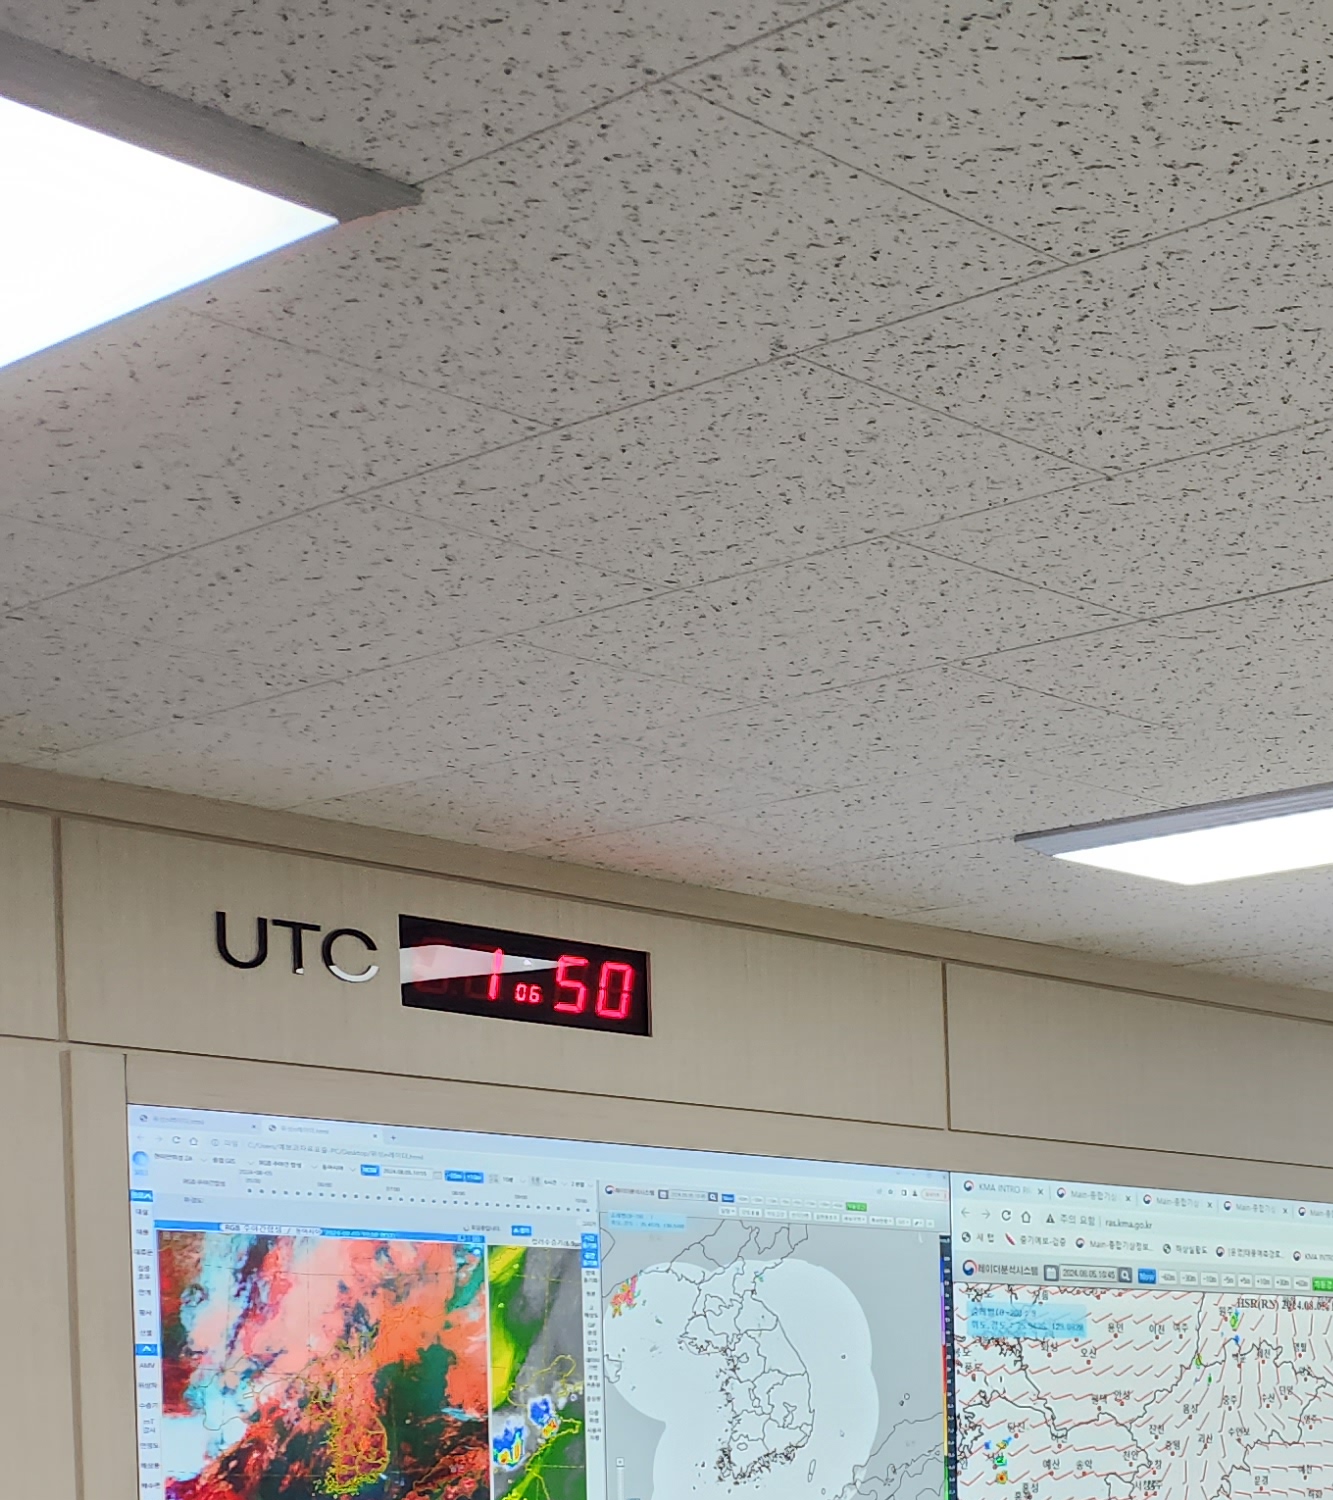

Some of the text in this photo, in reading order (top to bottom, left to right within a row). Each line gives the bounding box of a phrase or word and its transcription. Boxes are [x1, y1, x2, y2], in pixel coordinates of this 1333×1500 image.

[216, 911, 380, 984] UTC
[554, 954, 637, 1020] 50
[1060, 1213, 1077, 1225] 주의
[1078, 1215, 1096, 1226] 요함
[978, 1262, 1039, 1277] 레이더분석시스템
[1108, 1322, 1125, 1334] 용인
[1149, 1324, 1166, 1336] 이천
[1080, 1347, 1098, 1359] 오산
[1198, 1433, 1214, 1445] 괴산
[1123, 1450, 1139, 1462] 천안
[1043, 1458, 1061, 1470] 예산
[1076, 1458, 1093, 1470] 송악
